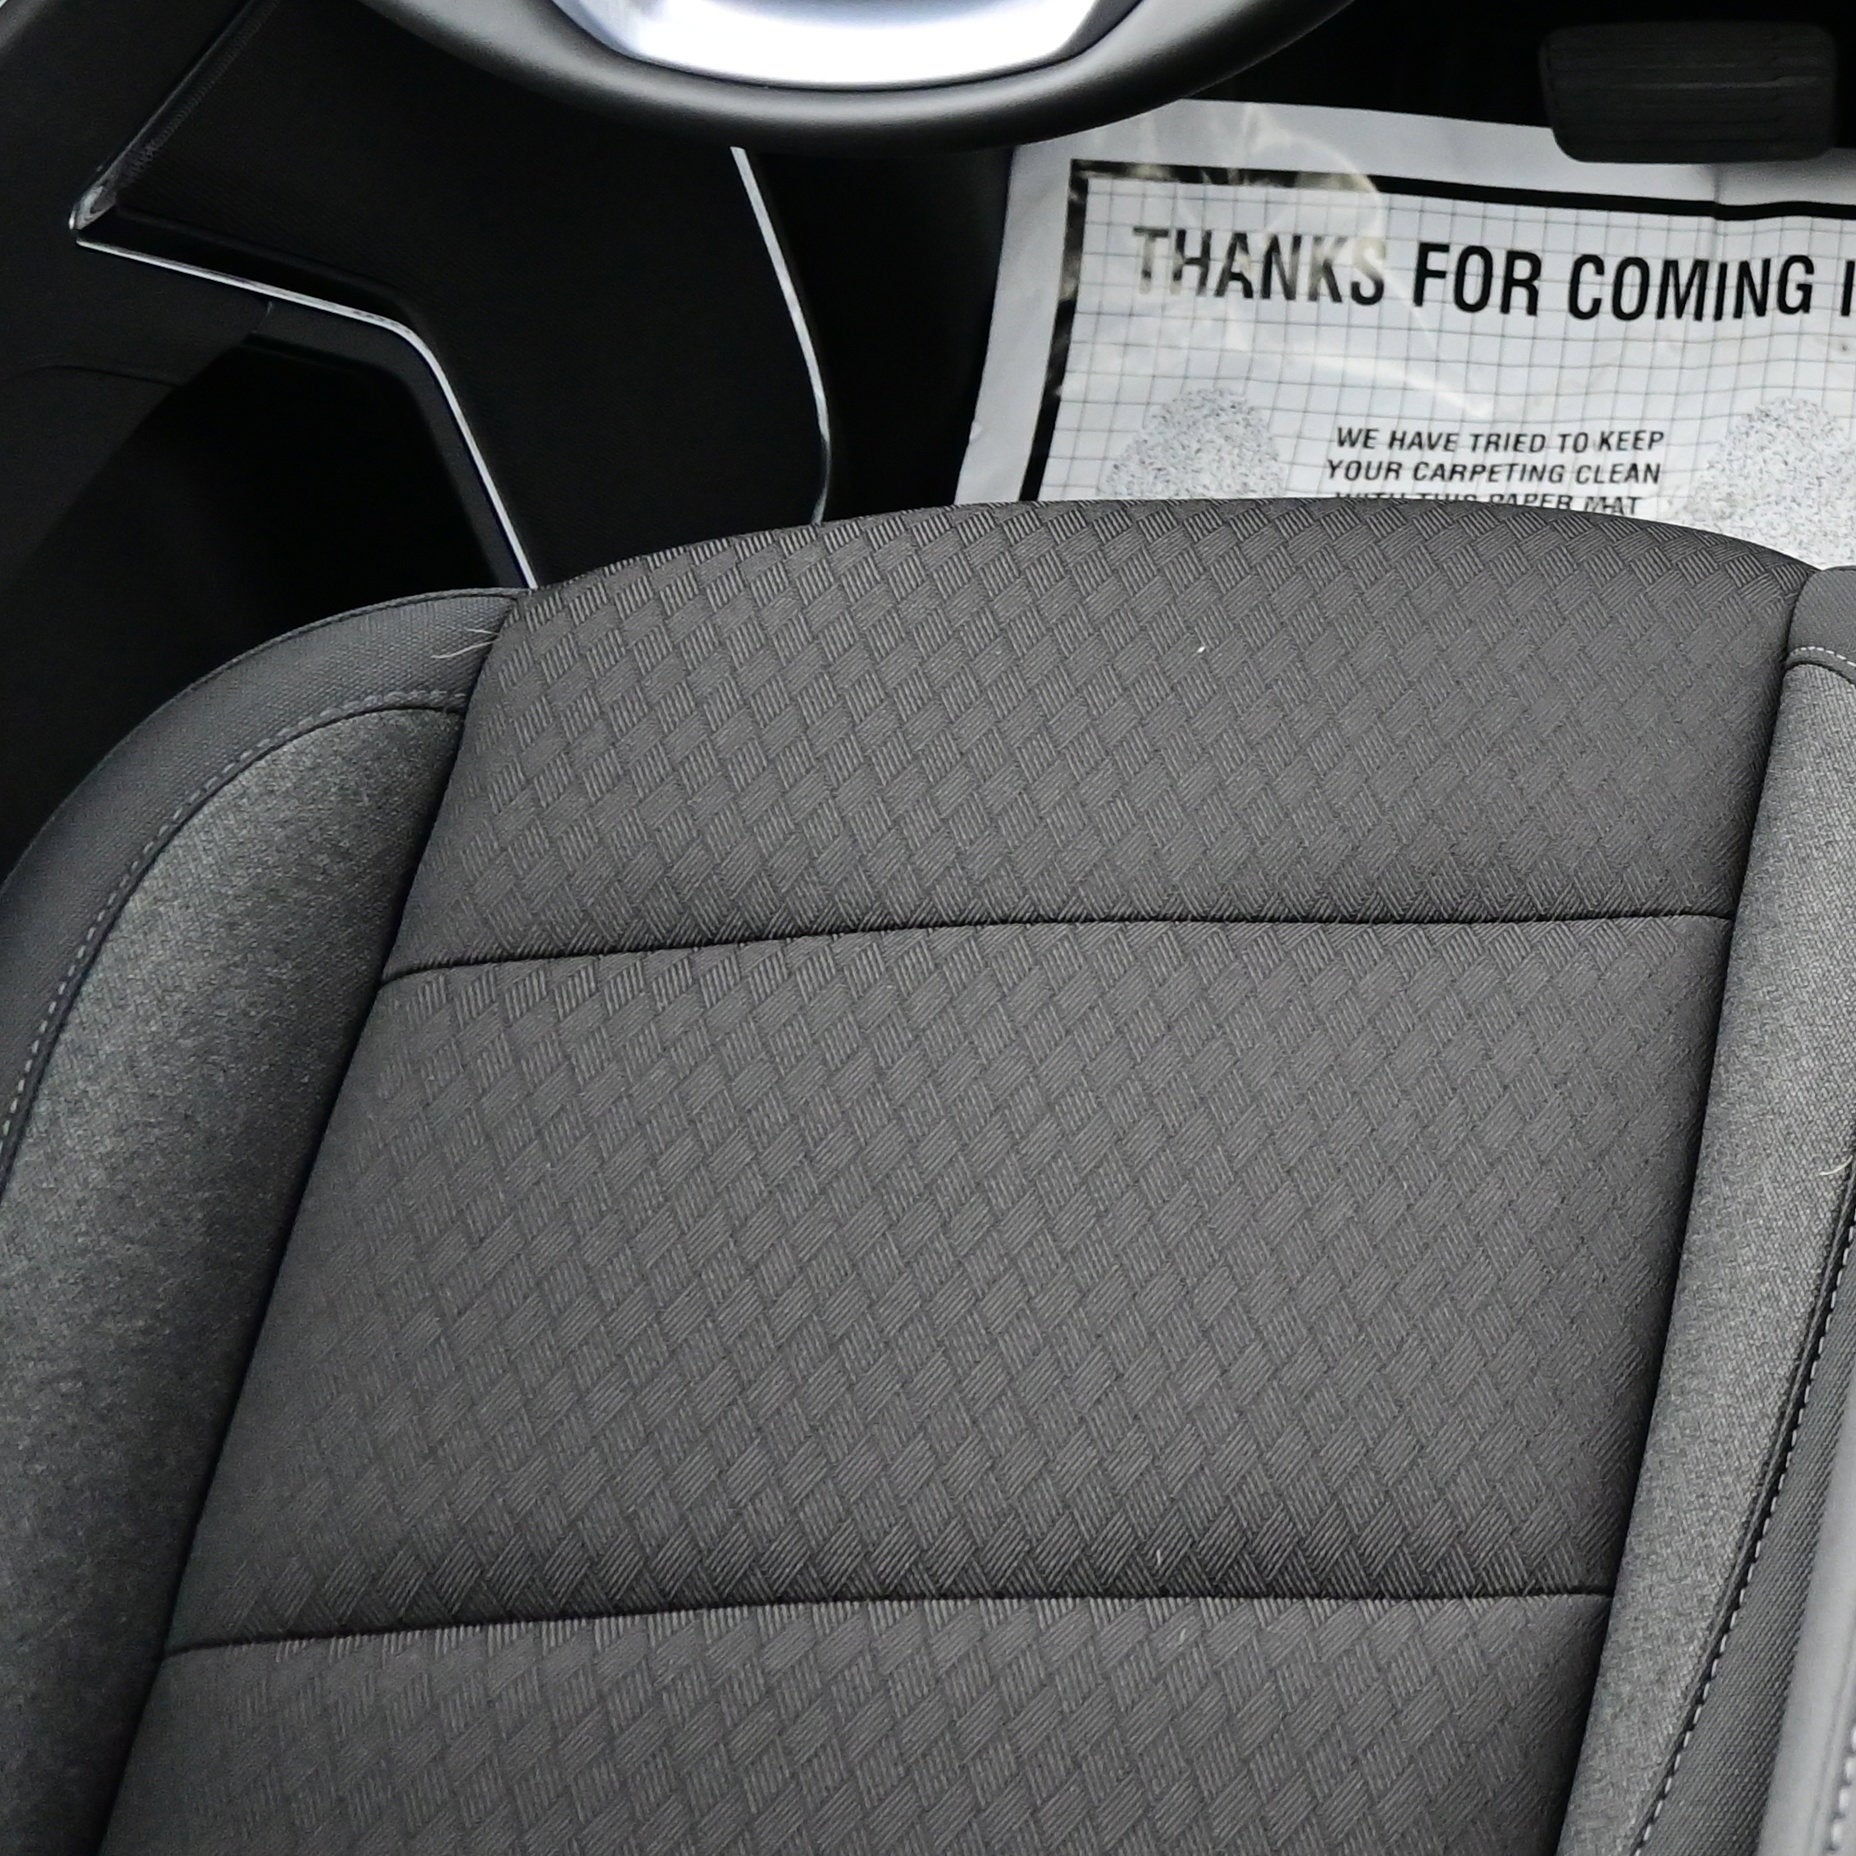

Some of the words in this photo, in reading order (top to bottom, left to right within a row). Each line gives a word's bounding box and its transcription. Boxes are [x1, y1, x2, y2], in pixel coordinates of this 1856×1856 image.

[1132, 225, 1388, 308] THANKS
[1411, 243, 1543, 318] FOR
[1567, 253, 1816, 323] COMING
[1336, 426, 1378, 450] WE
[1388, 429, 1459, 453] HAVE
[1469, 432, 1546, 454] TRIED
[1558, 432, 1588, 453] TO
[1596, 430, 1665, 451] KEEP
[1327, 459, 1402, 481] YOUR
[1412, 461, 1565, 484] CARPETING
[1575, 462, 1662, 485] CLEAN
[1584, 496, 1641, 515] MAT
